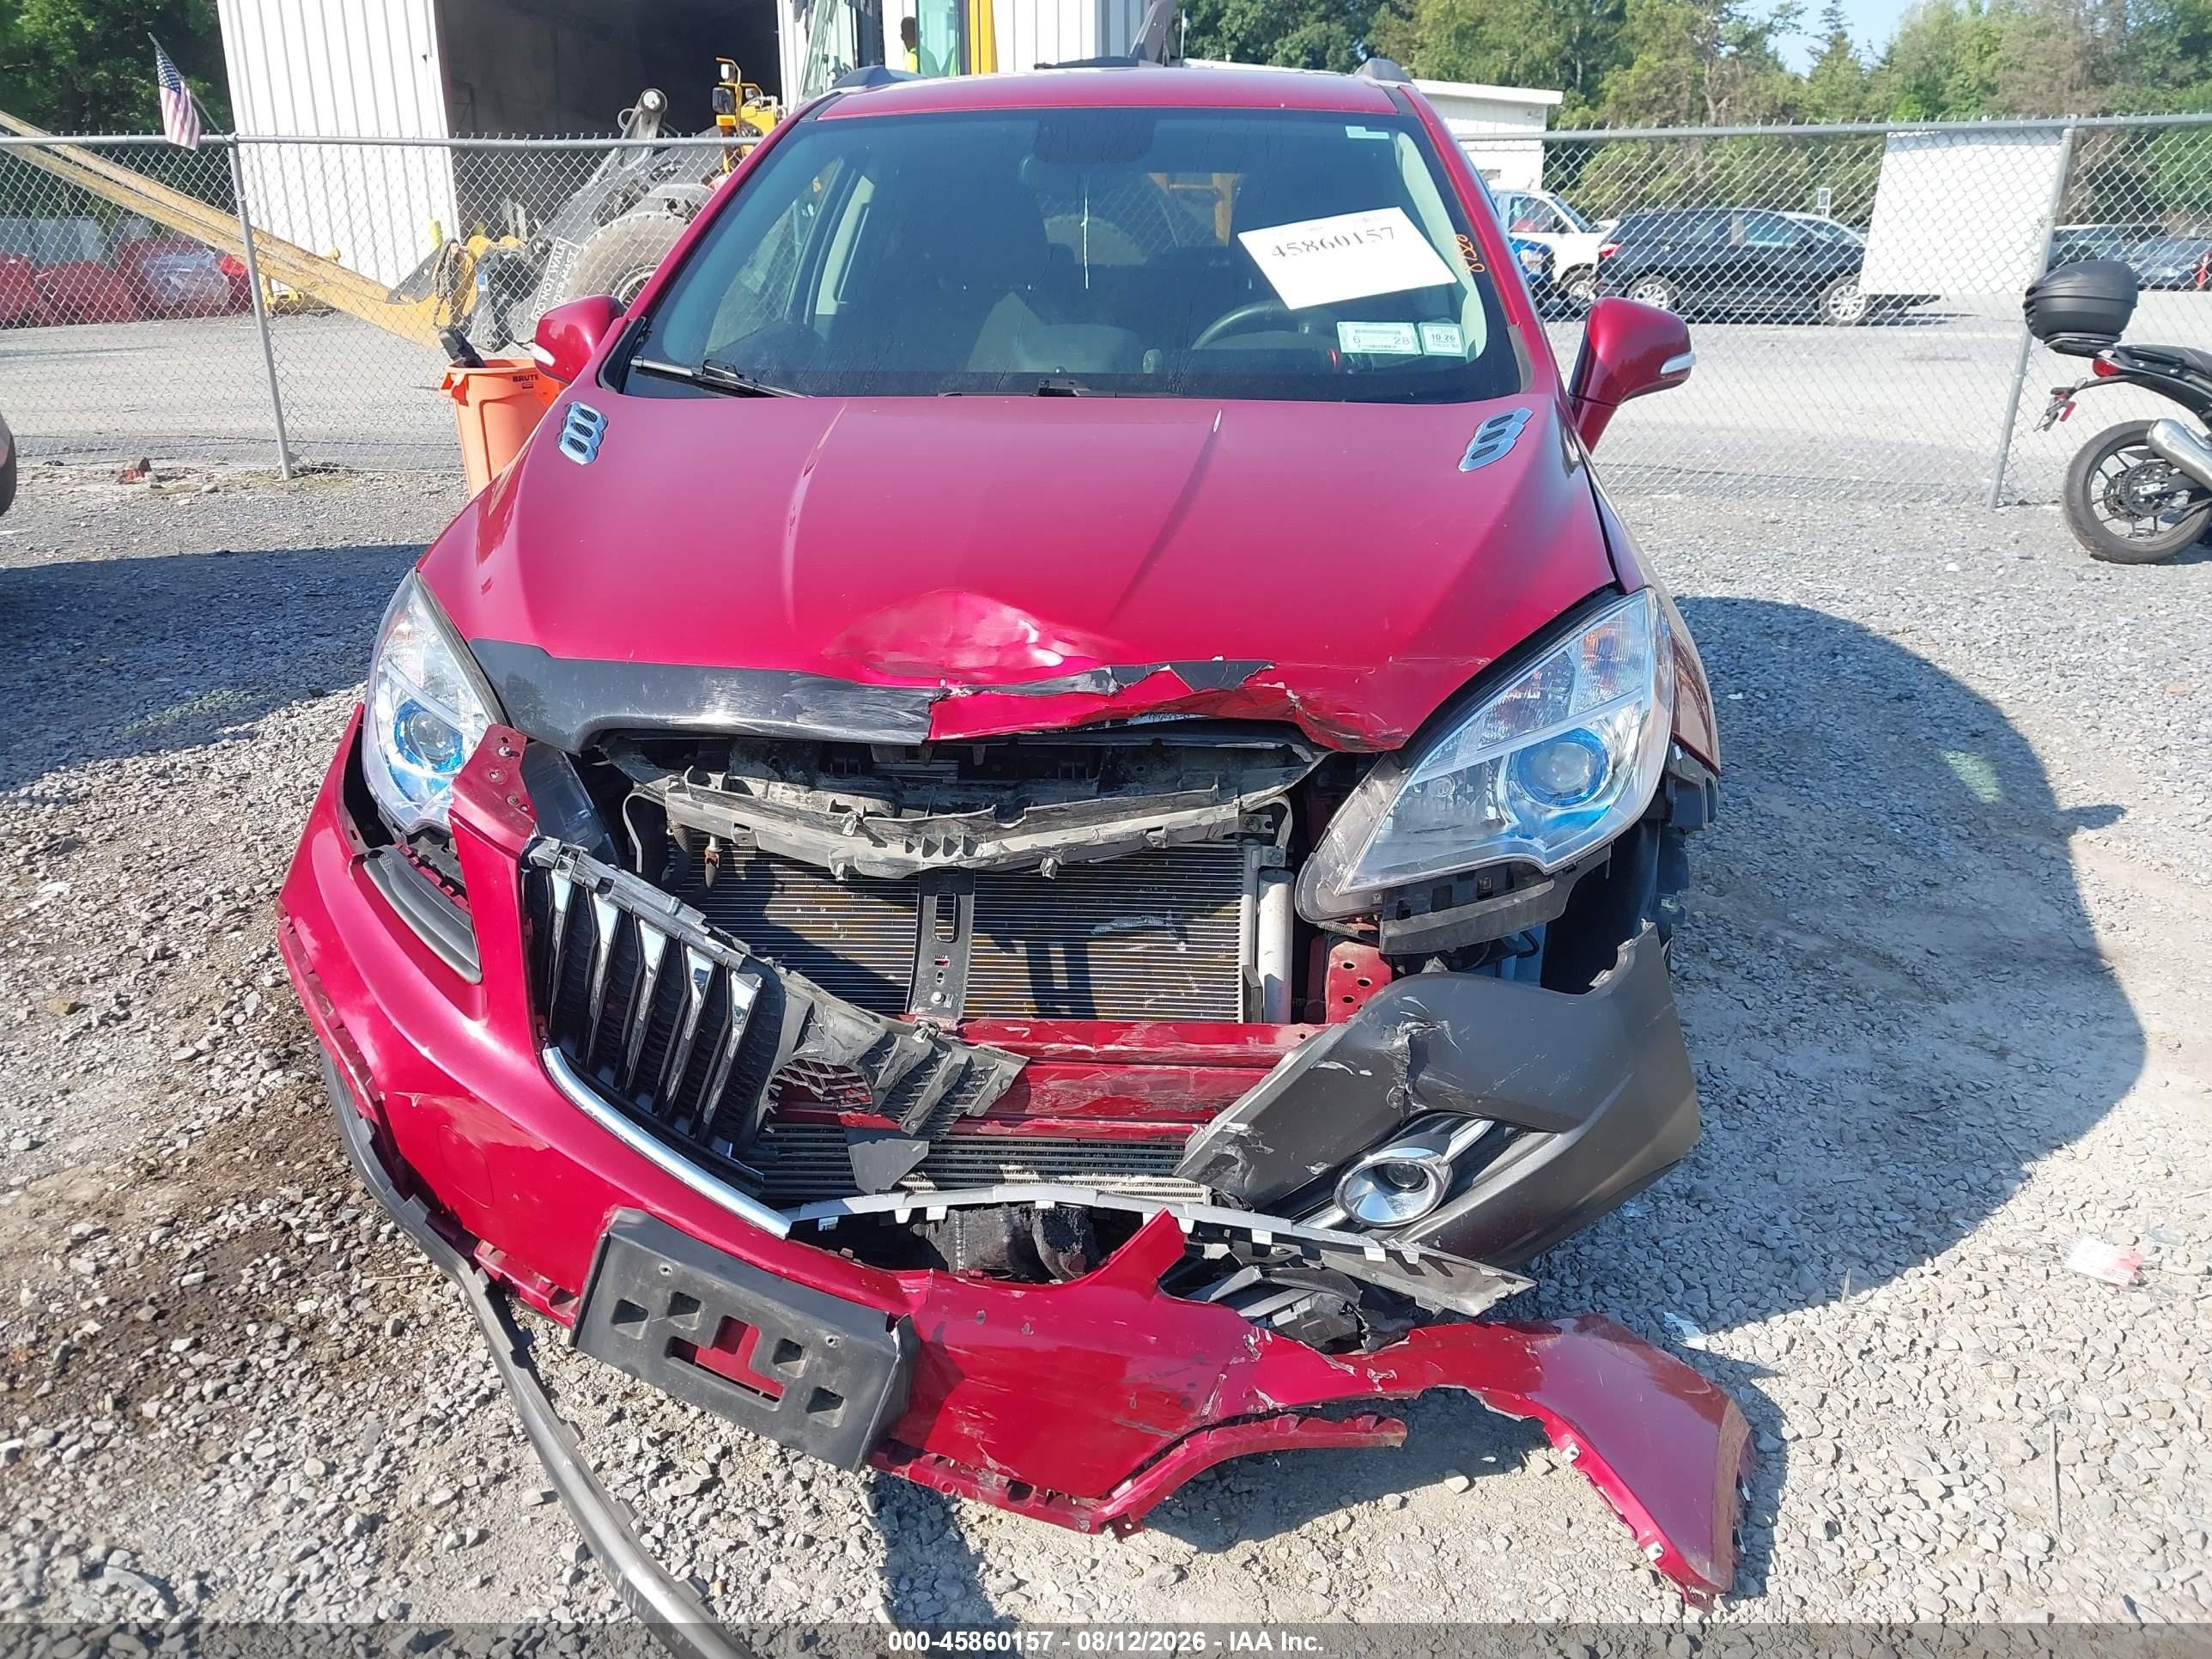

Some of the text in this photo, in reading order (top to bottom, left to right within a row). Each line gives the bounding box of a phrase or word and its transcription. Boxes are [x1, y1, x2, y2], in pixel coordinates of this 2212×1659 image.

[1272, 226, 1395, 258] 45860157
[534, 240, 568, 319] DO NOT WALK
